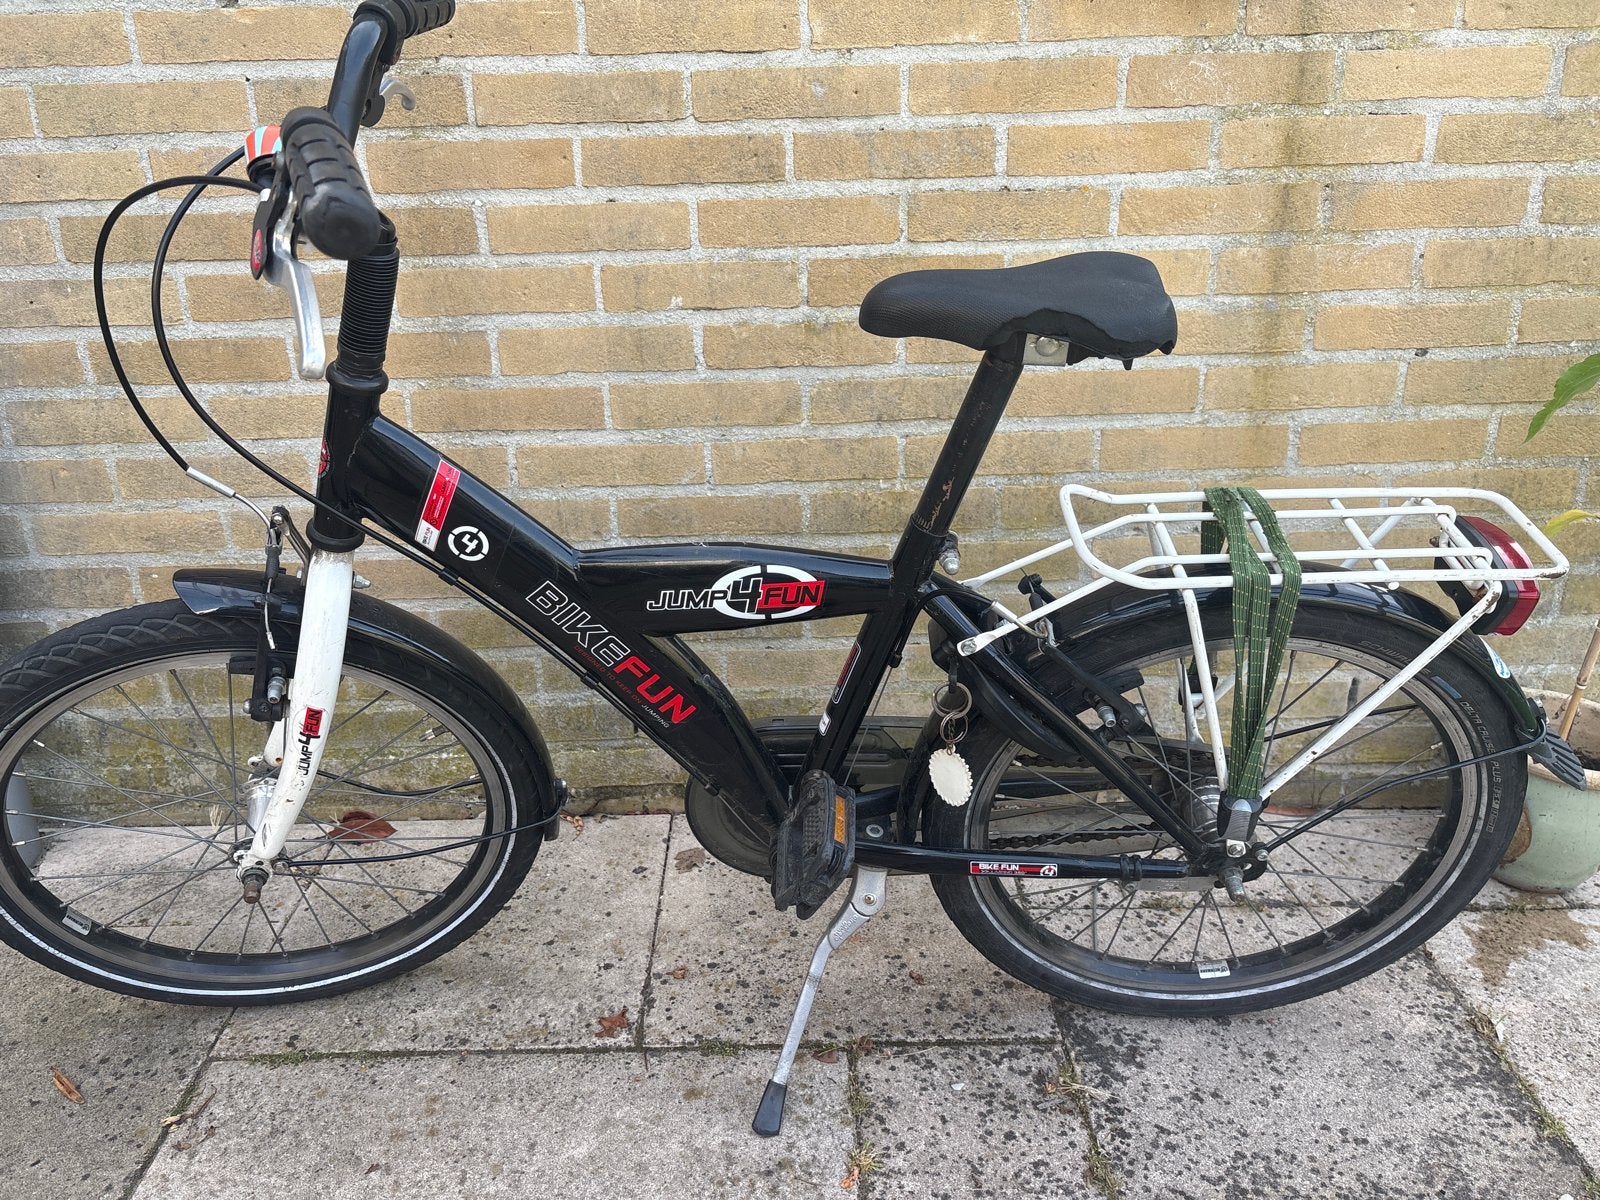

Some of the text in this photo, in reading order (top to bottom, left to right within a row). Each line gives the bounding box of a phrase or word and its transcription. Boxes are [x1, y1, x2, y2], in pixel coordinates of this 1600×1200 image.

[574, 645, 670, 728] DESIGNED TO KEEP ON JUMPING
[1460, 701, 1482, 724] DELTA
[978, 863, 999, 871] BIKE
[1000, 863, 1020, 871] FUN
